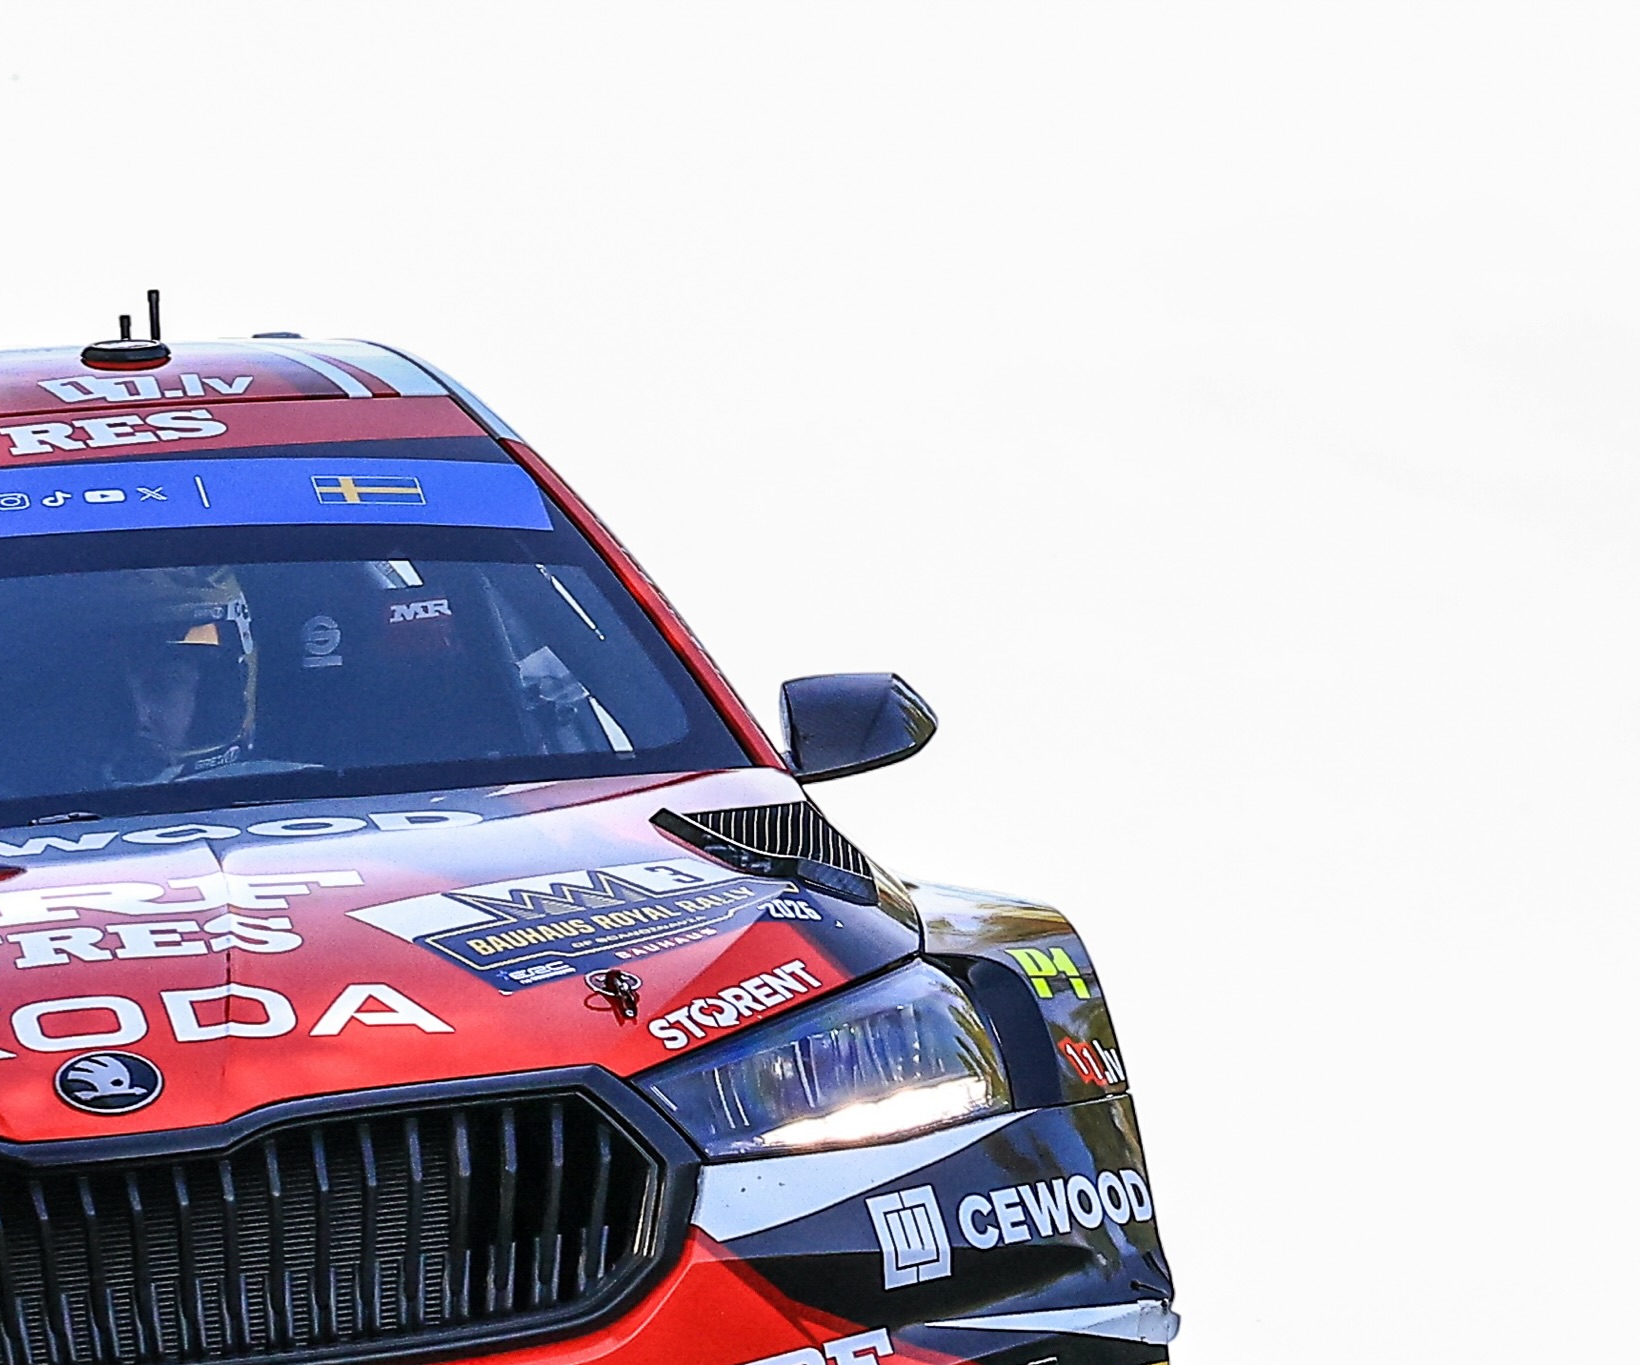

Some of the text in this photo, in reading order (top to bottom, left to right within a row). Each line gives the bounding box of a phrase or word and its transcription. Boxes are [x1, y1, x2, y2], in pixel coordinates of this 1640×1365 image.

[644, 865, 704, 884] 3
[465, 885, 756, 957] BAUHAUS ROYAL RALLY
[757, 899, 823, 921] 2026
[614, 928, 718, 960] BAUHAUS
[958, 1169, 1153, 1250] CEWOOD
